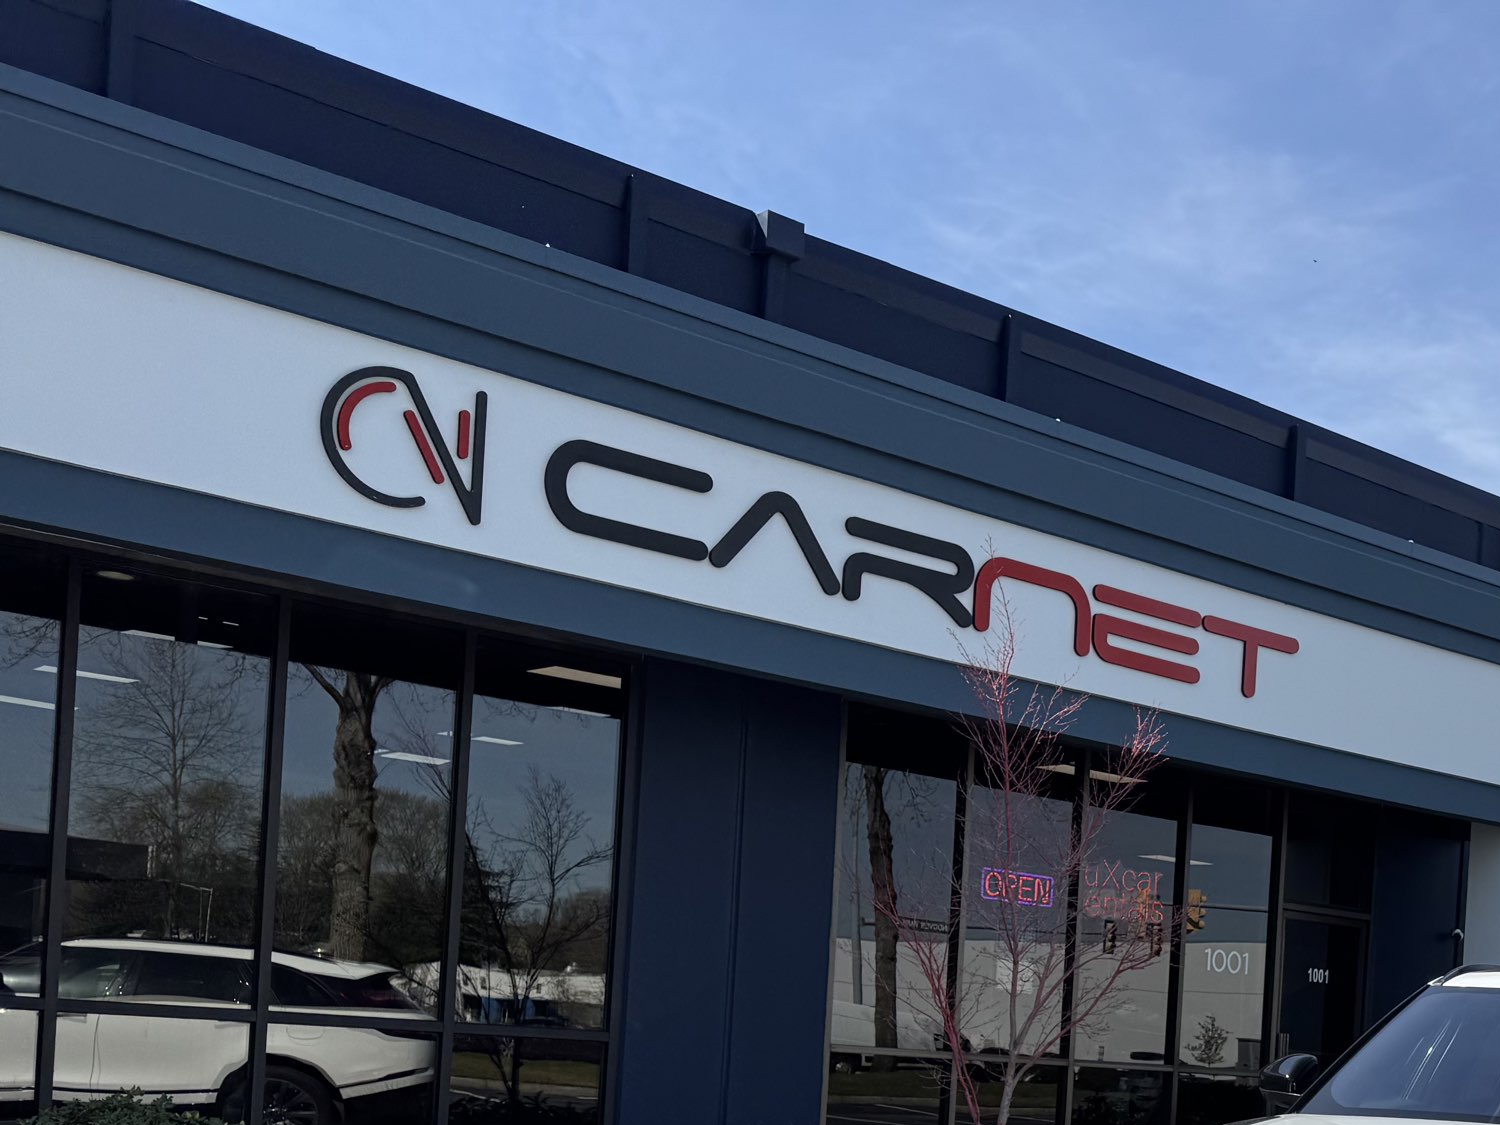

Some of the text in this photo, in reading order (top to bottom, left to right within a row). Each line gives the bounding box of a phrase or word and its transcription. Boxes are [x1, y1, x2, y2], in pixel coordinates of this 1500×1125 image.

[543, 438, 1300, 698] CARNET
[984, 871, 1050, 904] OPEN
[1083, 858, 1163, 896] uXcar
[1083, 892, 1165, 924] entals
[1204, 948, 1250, 976] 1001
[1307, 967, 1330, 985] 1001
